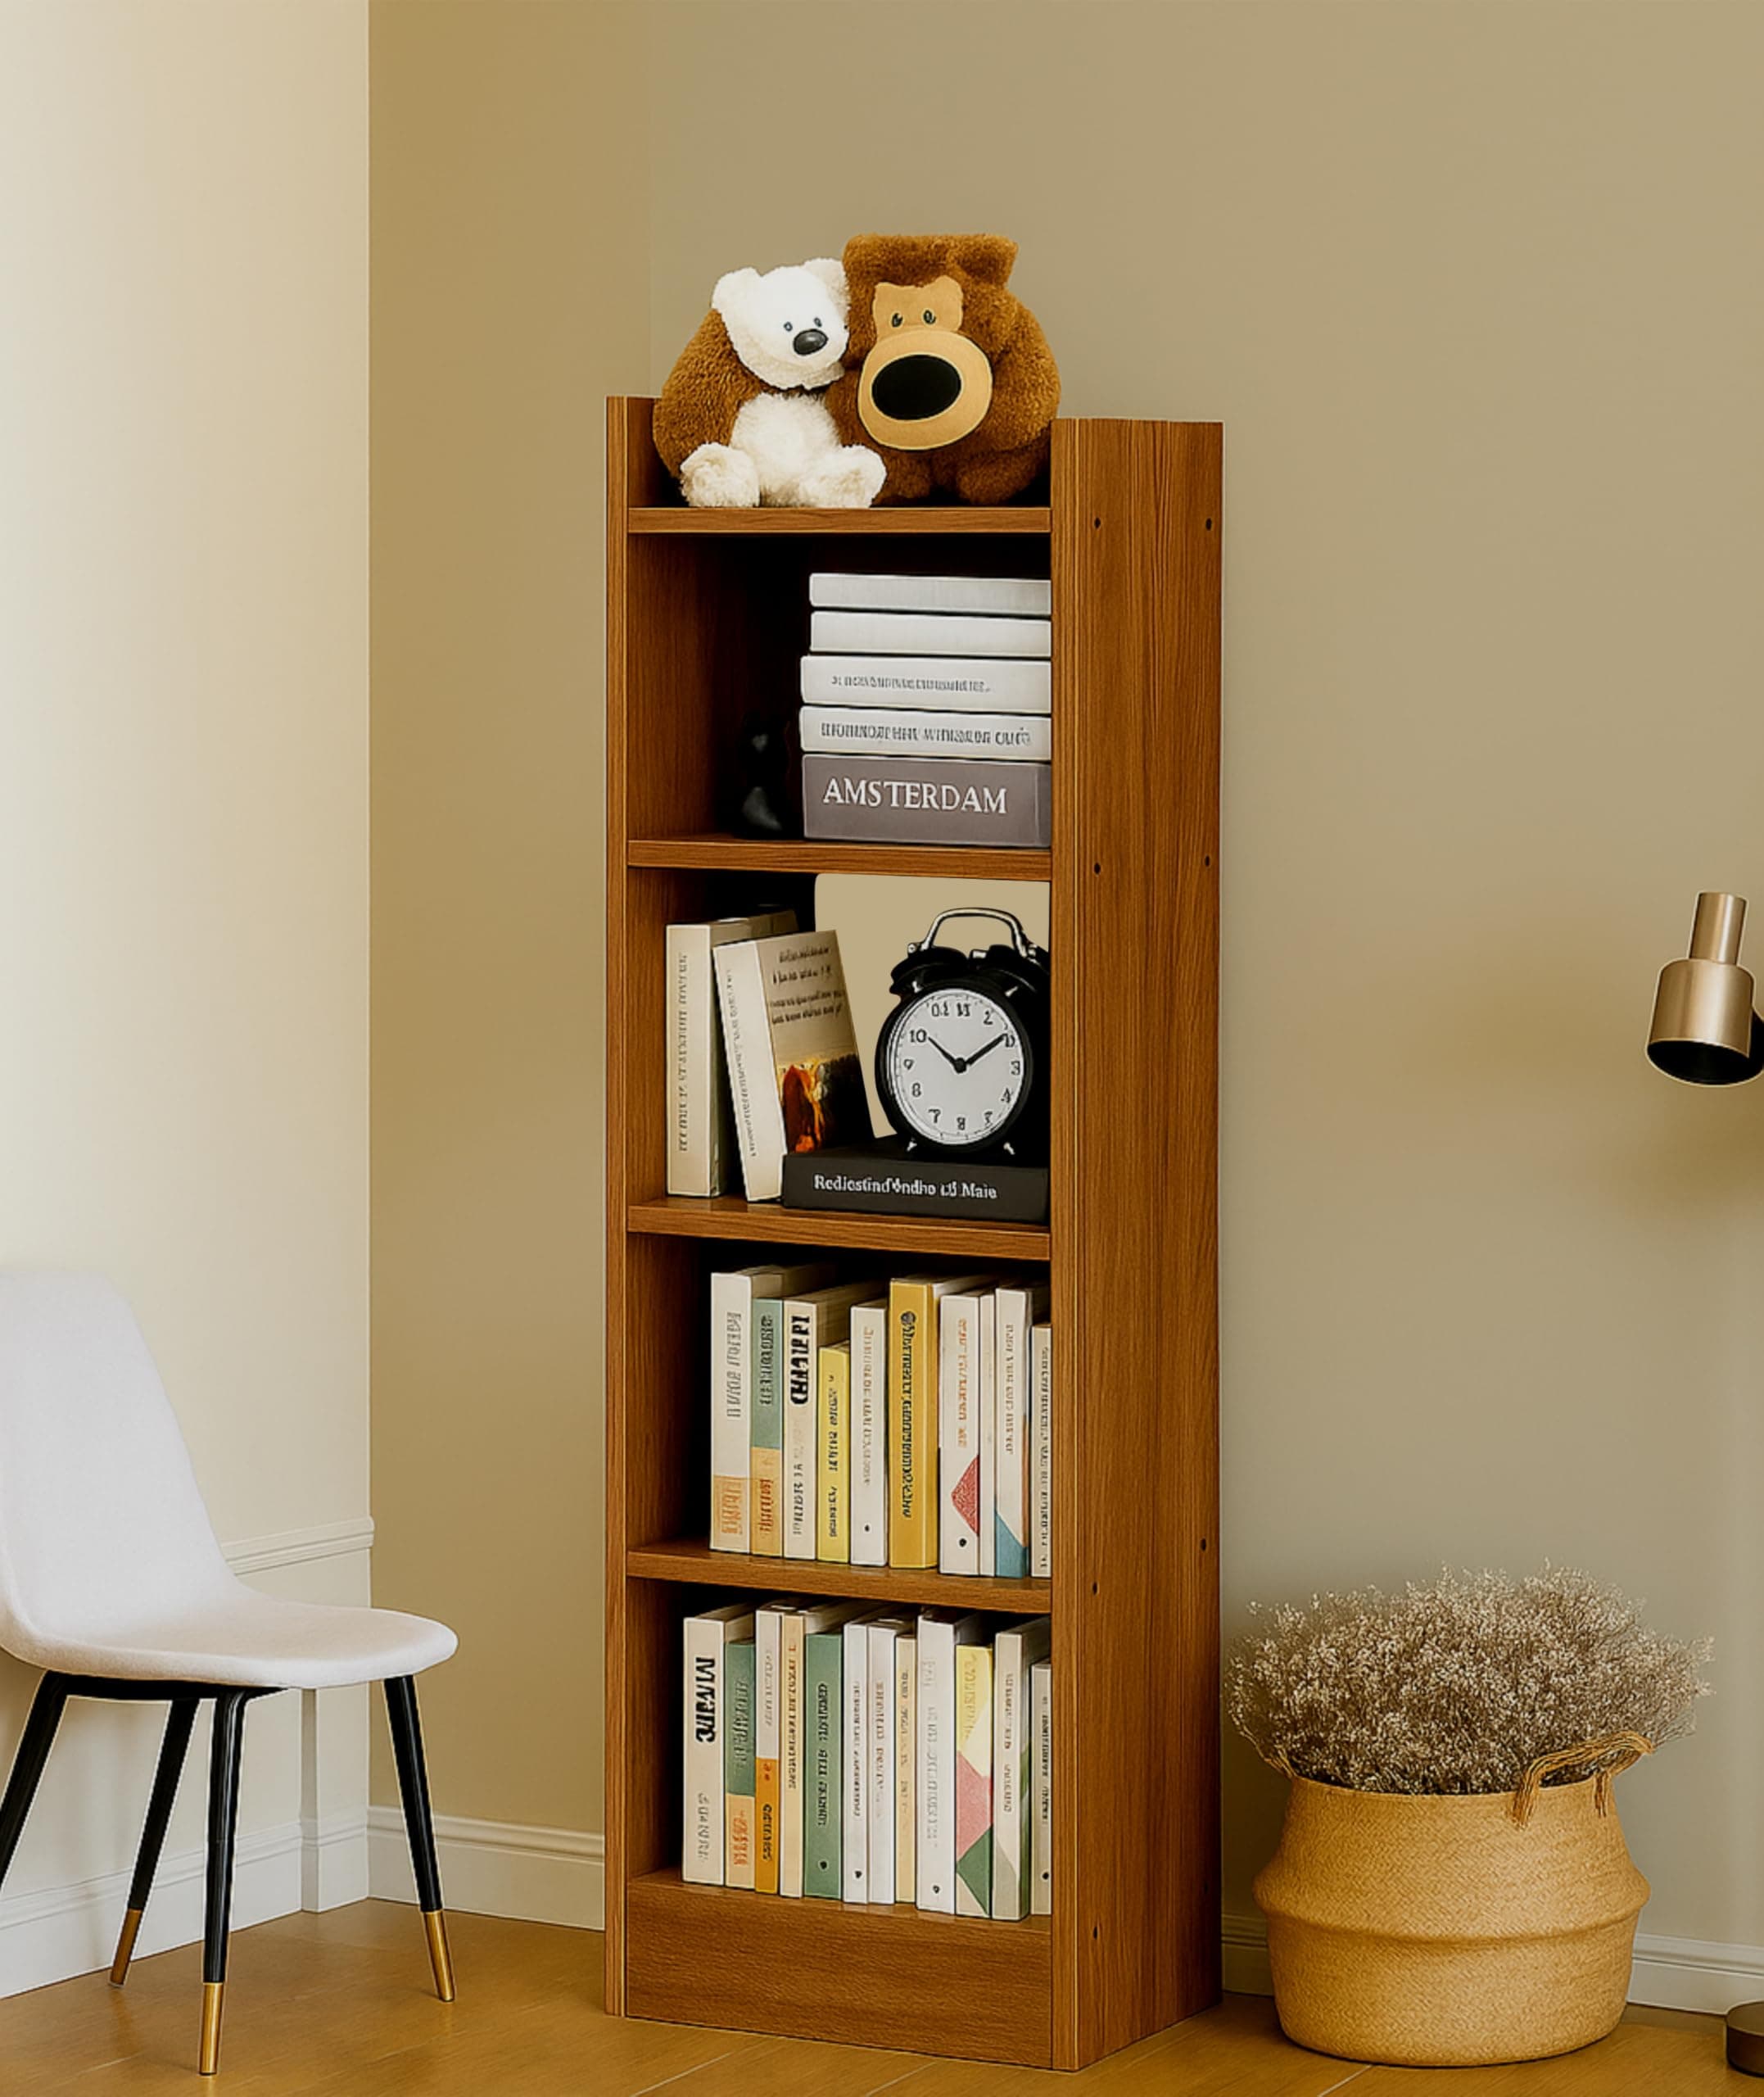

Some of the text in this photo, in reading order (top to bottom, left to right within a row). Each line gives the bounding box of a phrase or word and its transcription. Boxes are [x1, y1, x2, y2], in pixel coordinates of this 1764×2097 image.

[823, 777, 1007, 814] AMSTERDAM
[983, 1010, 993, 1026] 2
[909, 1029, 927, 1043] 10
[911, 1082, 922, 1098] 8
[928, 1108, 941, 1124] 7
